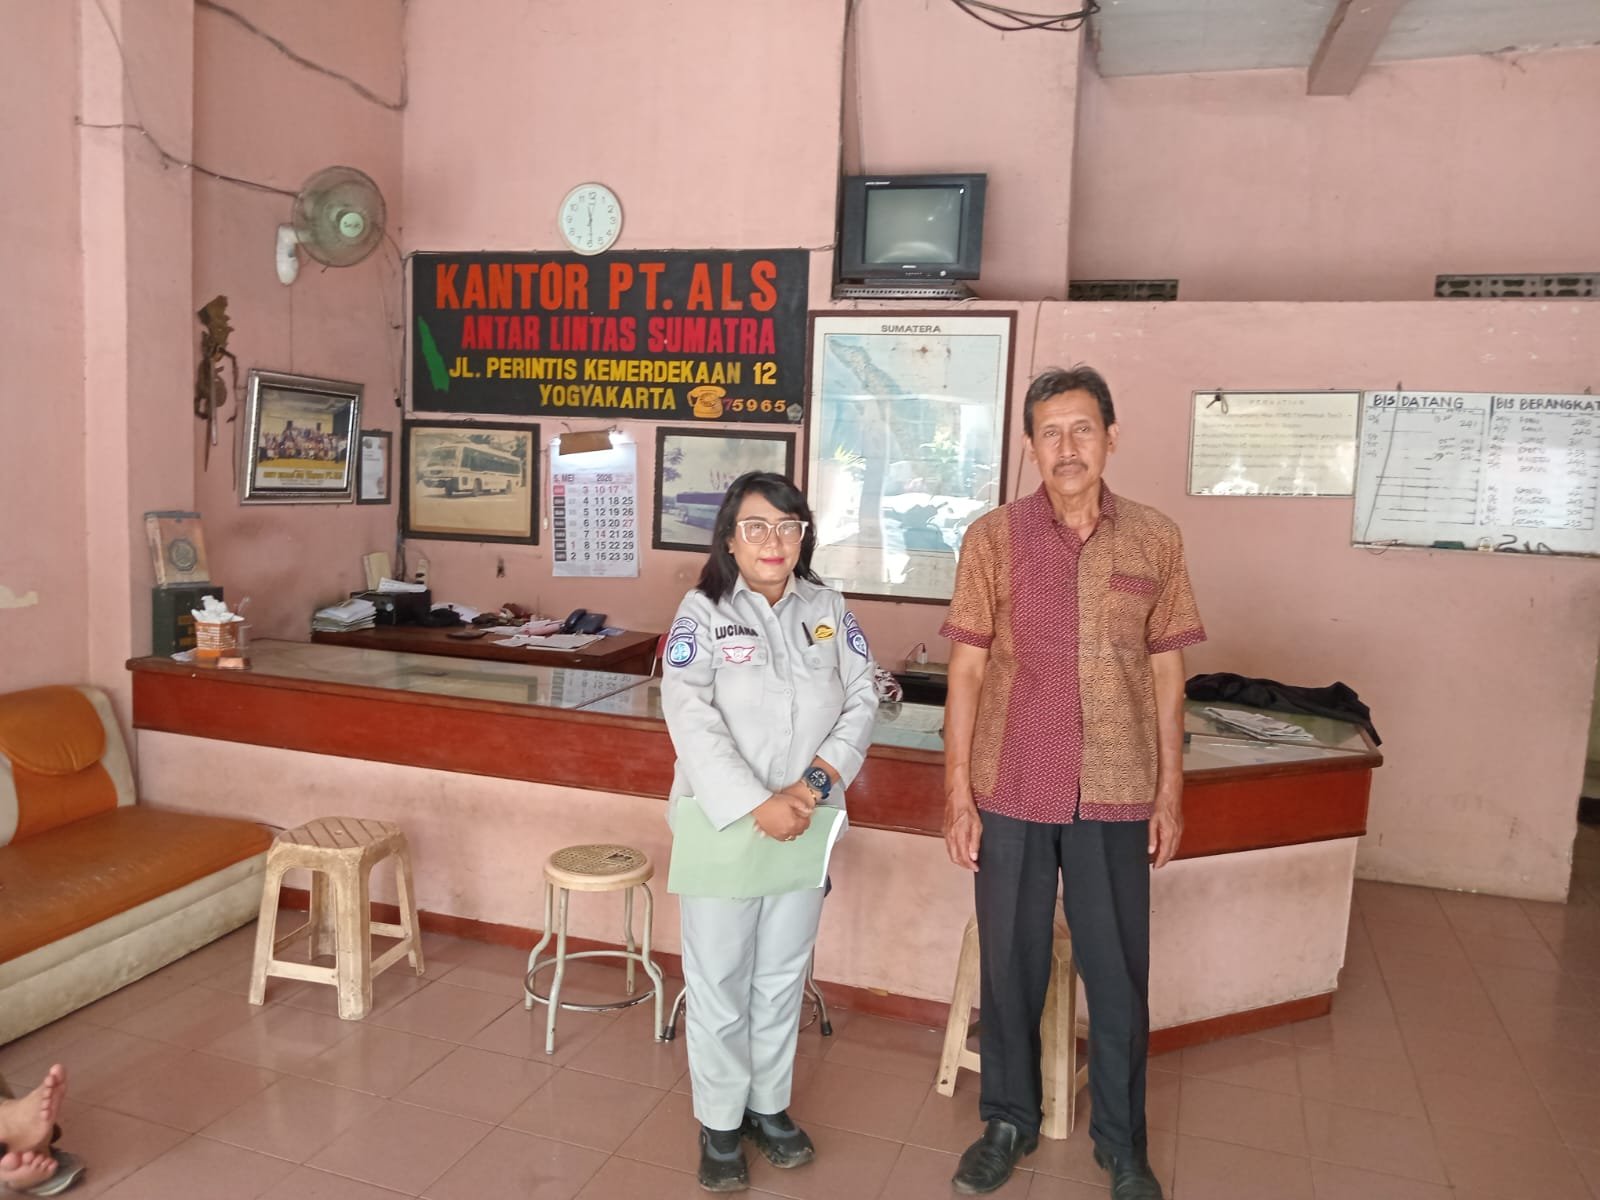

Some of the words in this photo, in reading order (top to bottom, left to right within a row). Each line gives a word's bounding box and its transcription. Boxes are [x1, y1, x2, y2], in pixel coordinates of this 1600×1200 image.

[588, 191, 596, 200] 12
[608, 205, 614, 213] 2
[436, 262, 589, 310] KANTOR
[608, 262, 673, 311] PT.
[686, 260, 777, 311] ALS
[881, 324, 941, 333] SUMATERA
[461, 315, 541, 349] ANTAR
[550, 315, 637, 352] LINTAS
[647, 317, 776, 354] SUMATRA
[449, 357, 481, 378] JL.
[486, 357, 577, 380] PERINTIS
[584, 358, 741, 385] KEMERDEKAAN
[753, 361, 777, 385] 12
[539, 384, 676, 411] YOGYAKARTA
[1373, 394, 1396, 407] BIS
[1401, 395, 1465, 409] DATANG
[1495, 397, 1515, 410] BIS
[561, 473, 575, 482] MEI
[609, 486, 619, 494] 17
[583, 497, 589, 505] 4
[595, 497, 605, 505] 11
[609, 497, 619, 505] 18
[622, 497, 633, 505] 25
[583, 508, 590, 516] 5
[595, 508, 606, 516] 12
[609, 508, 620, 516] 19
[622, 508, 634, 516] 26
[595, 520, 606, 528] 13
[609, 520, 620, 528] 20
[622, 520, 634, 528] 27
[583, 530, 590, 538] 7
[595, 530, 606, 538] 14
[609, 530, 620, 538] 21
[622, 530, 634, 538] 28
[571, 541, 576, 549] 1
[595, 541, 606, 549] 15
[609, 541, 620, 549] 22
[622, 541, 634, 549] 29
[571, 552, 576, 560] 2
[583, 552, 590, 560] 9
[609, 552, 620, 560] 23
[622, 552, 634, 560] 30
[714, 624, 759, 640] LUCIANA
